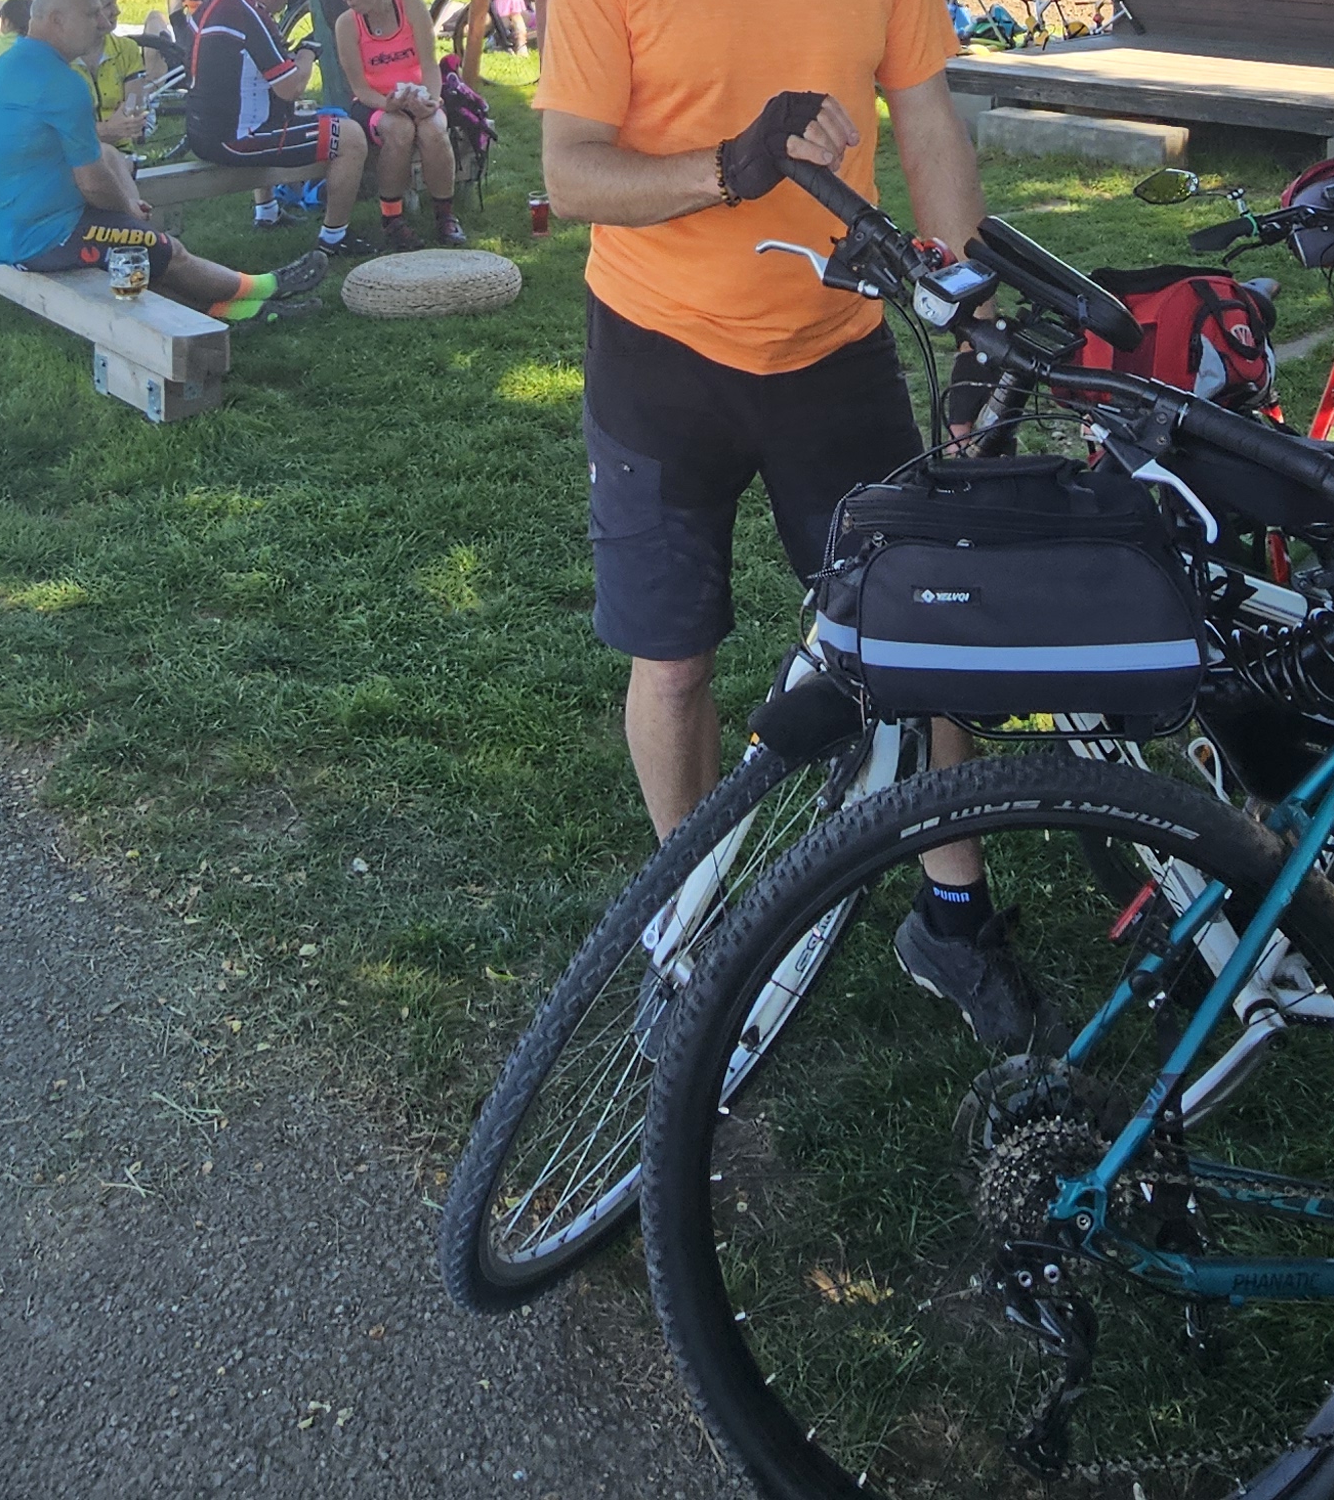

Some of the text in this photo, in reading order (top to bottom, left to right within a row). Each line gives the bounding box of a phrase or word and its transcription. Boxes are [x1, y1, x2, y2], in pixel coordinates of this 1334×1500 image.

[82, 225, 157, 247] JUMBO
[950, 800, 1200, 840] SMART SAM
[932, 886, 971, 903] PUMA
[1232, 1271, 1321, 1291] PHANATIC
